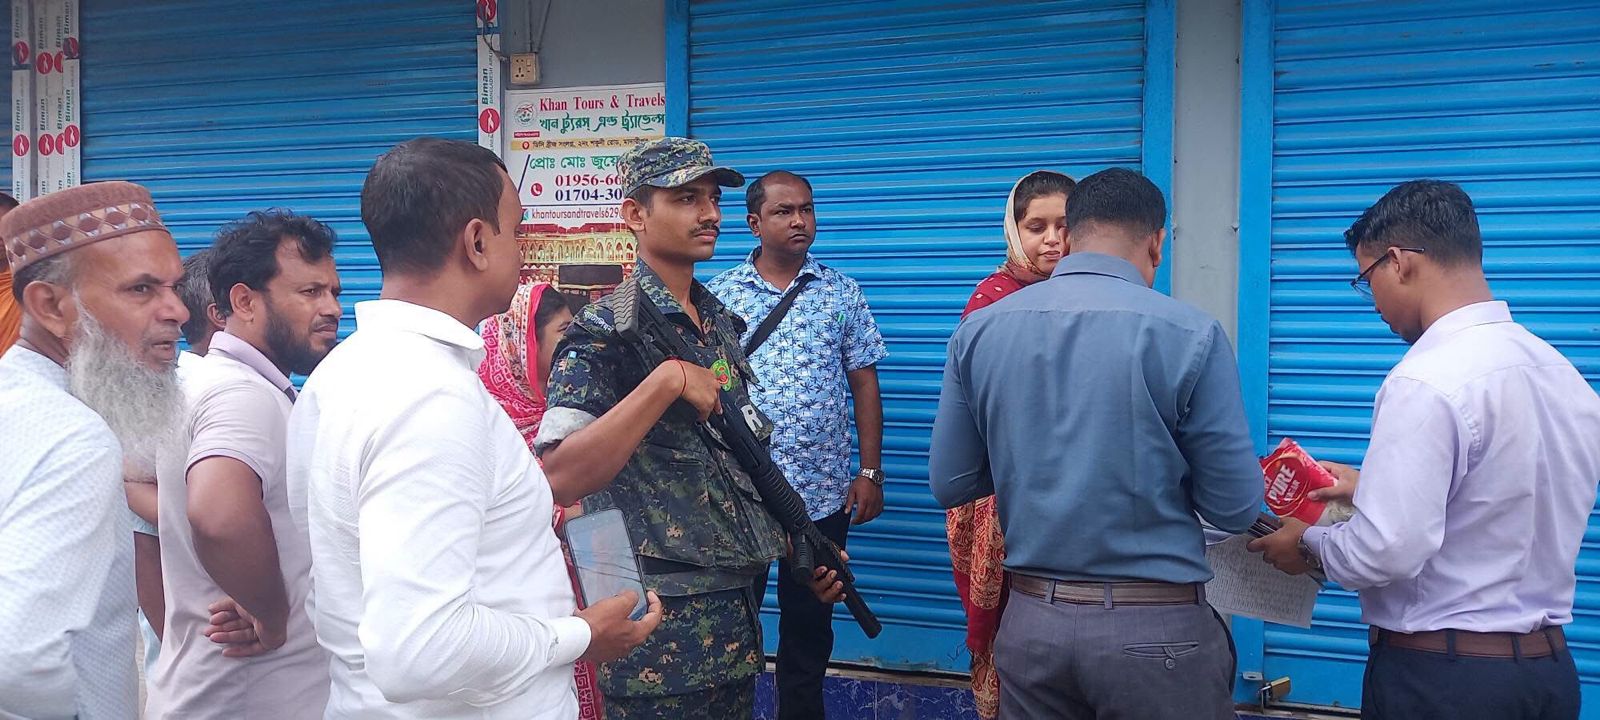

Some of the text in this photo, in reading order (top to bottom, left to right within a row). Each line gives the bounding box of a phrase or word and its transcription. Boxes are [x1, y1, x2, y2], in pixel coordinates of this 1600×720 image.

[540, 92, 665, 112] Khan Tours & Travels
[540, 117, 558, 131] খান
[529, 155, 620, 170] প্রোঃ মোঃ জুয়ে
[555, 174, 622, 187] 01956-66
[555, 188, 623, 201] 01704-30
[1267, 464, 1296, 504] PURE
